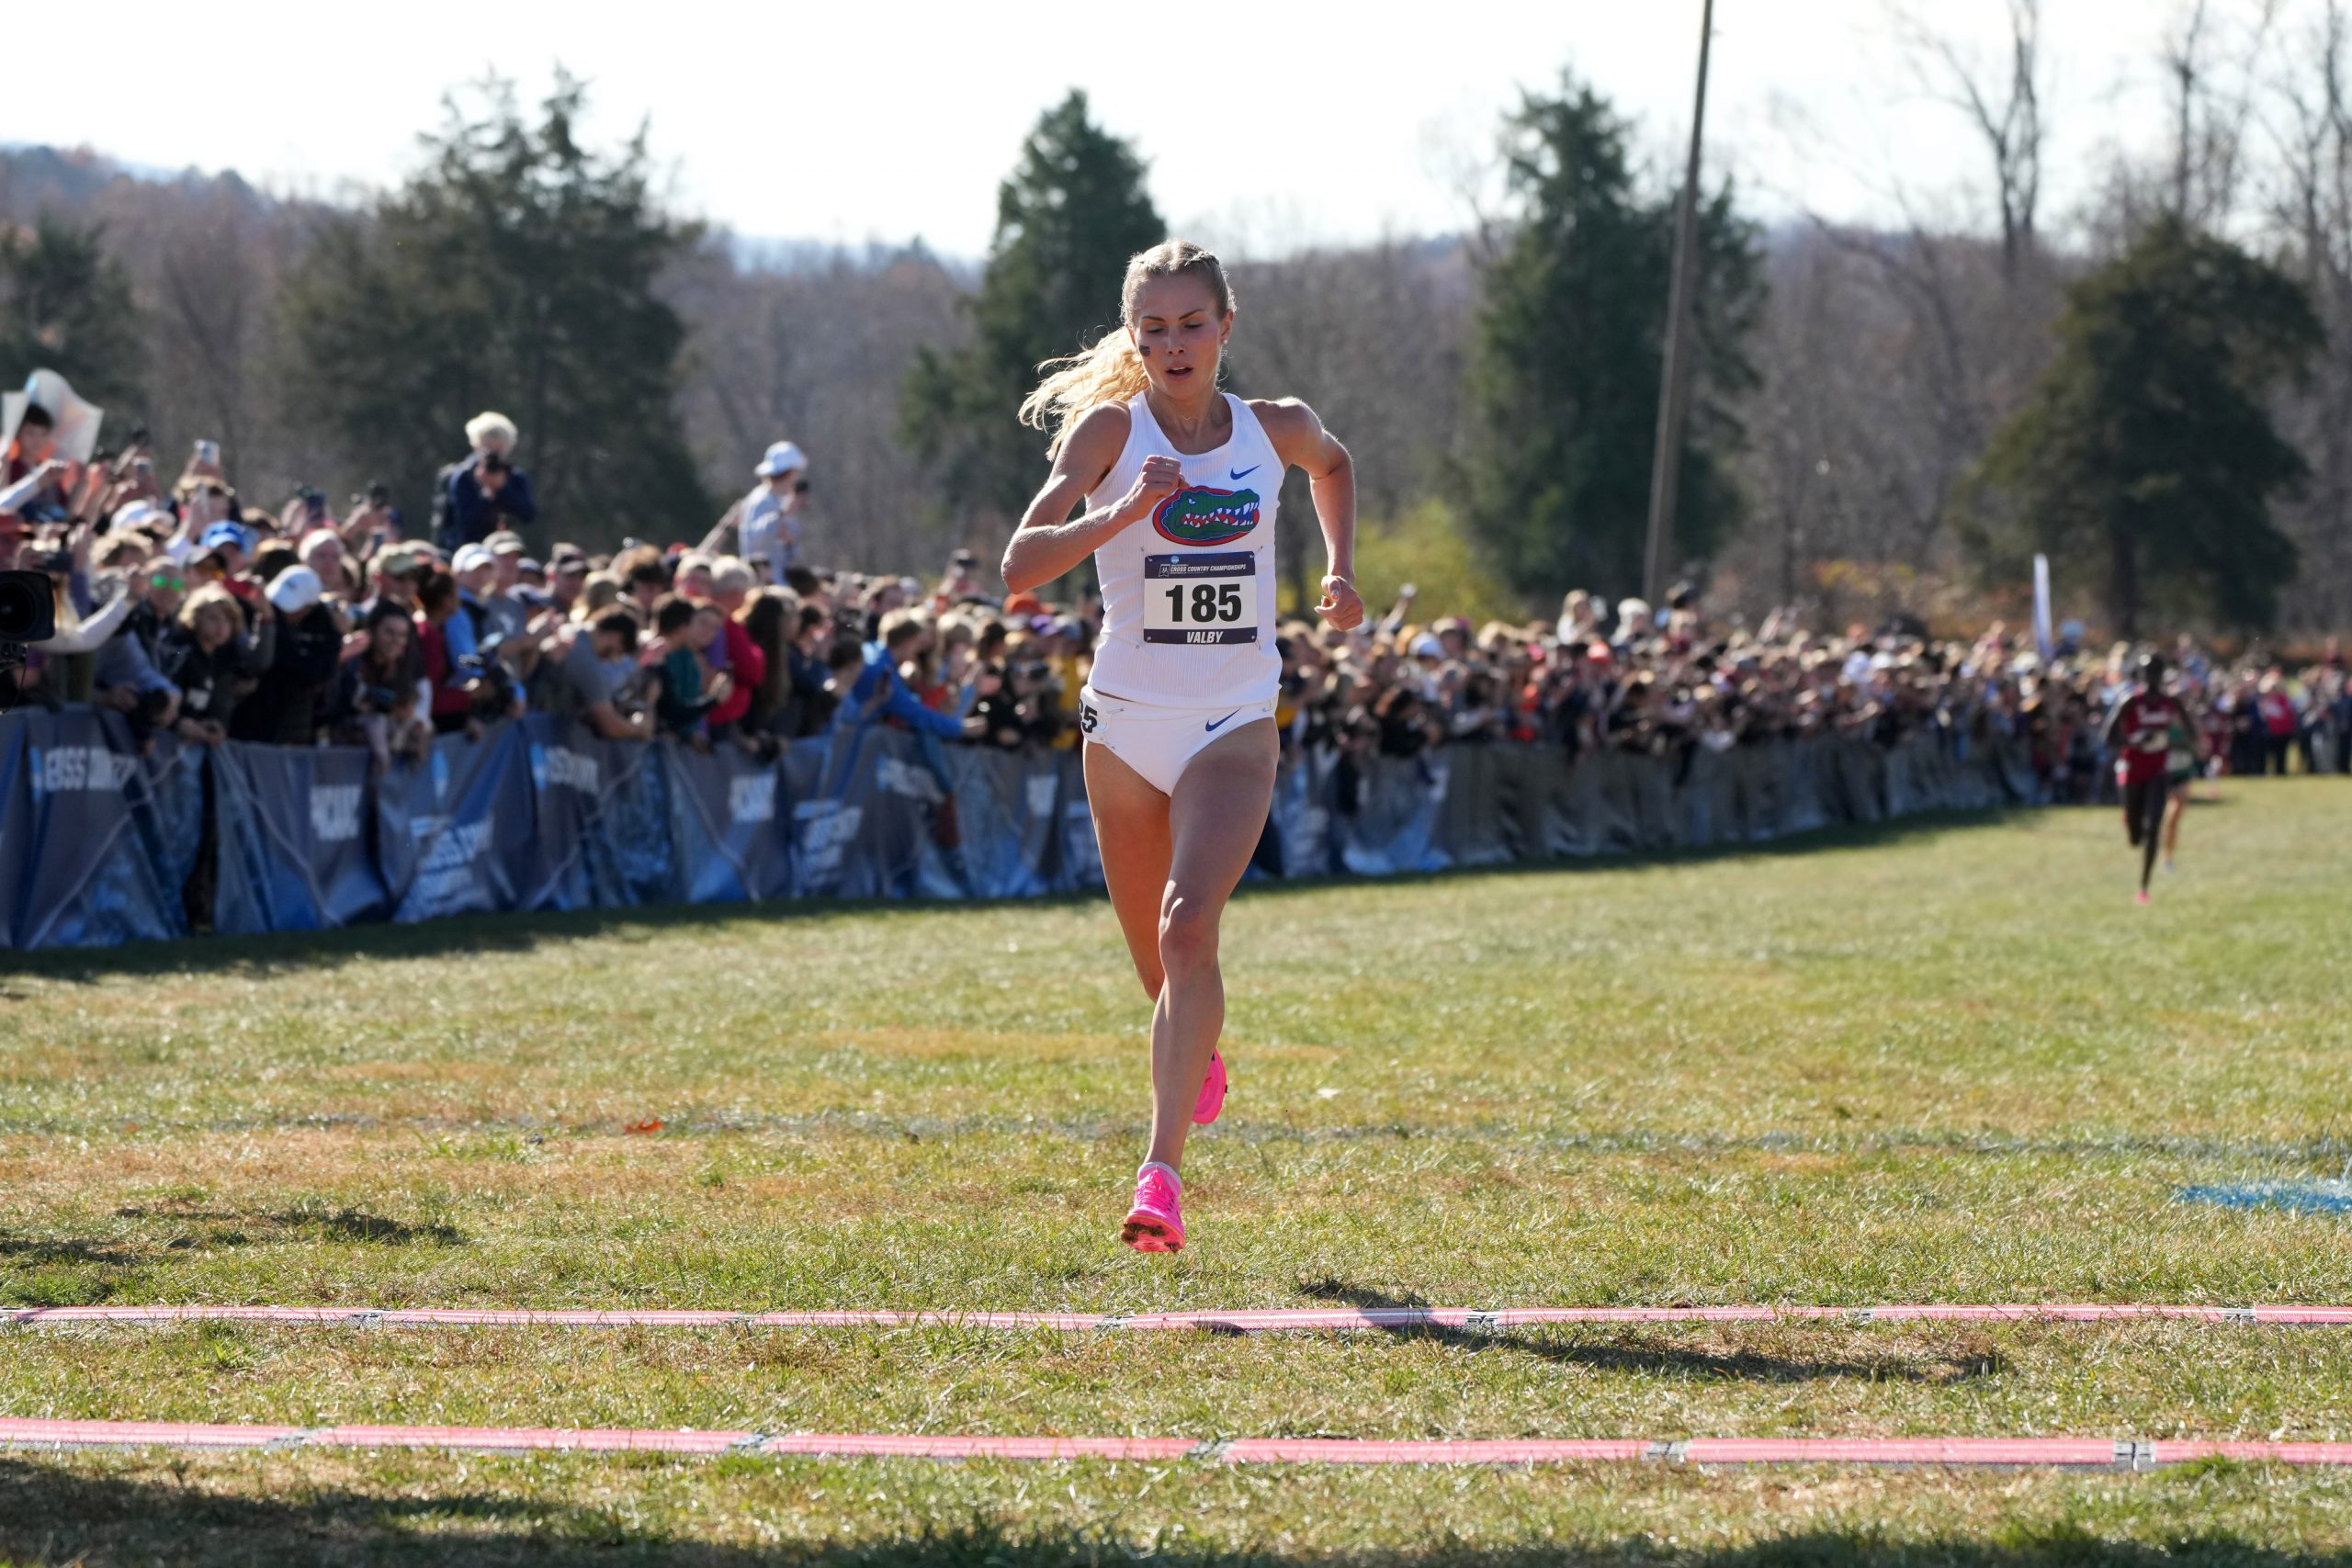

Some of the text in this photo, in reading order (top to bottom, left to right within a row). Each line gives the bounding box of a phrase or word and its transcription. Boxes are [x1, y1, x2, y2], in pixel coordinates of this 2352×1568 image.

[1166, 584, 1241, 622] 185
[1187, 631, 1224, 644] VALBY
[1080, 699, 1097, 733] 5
